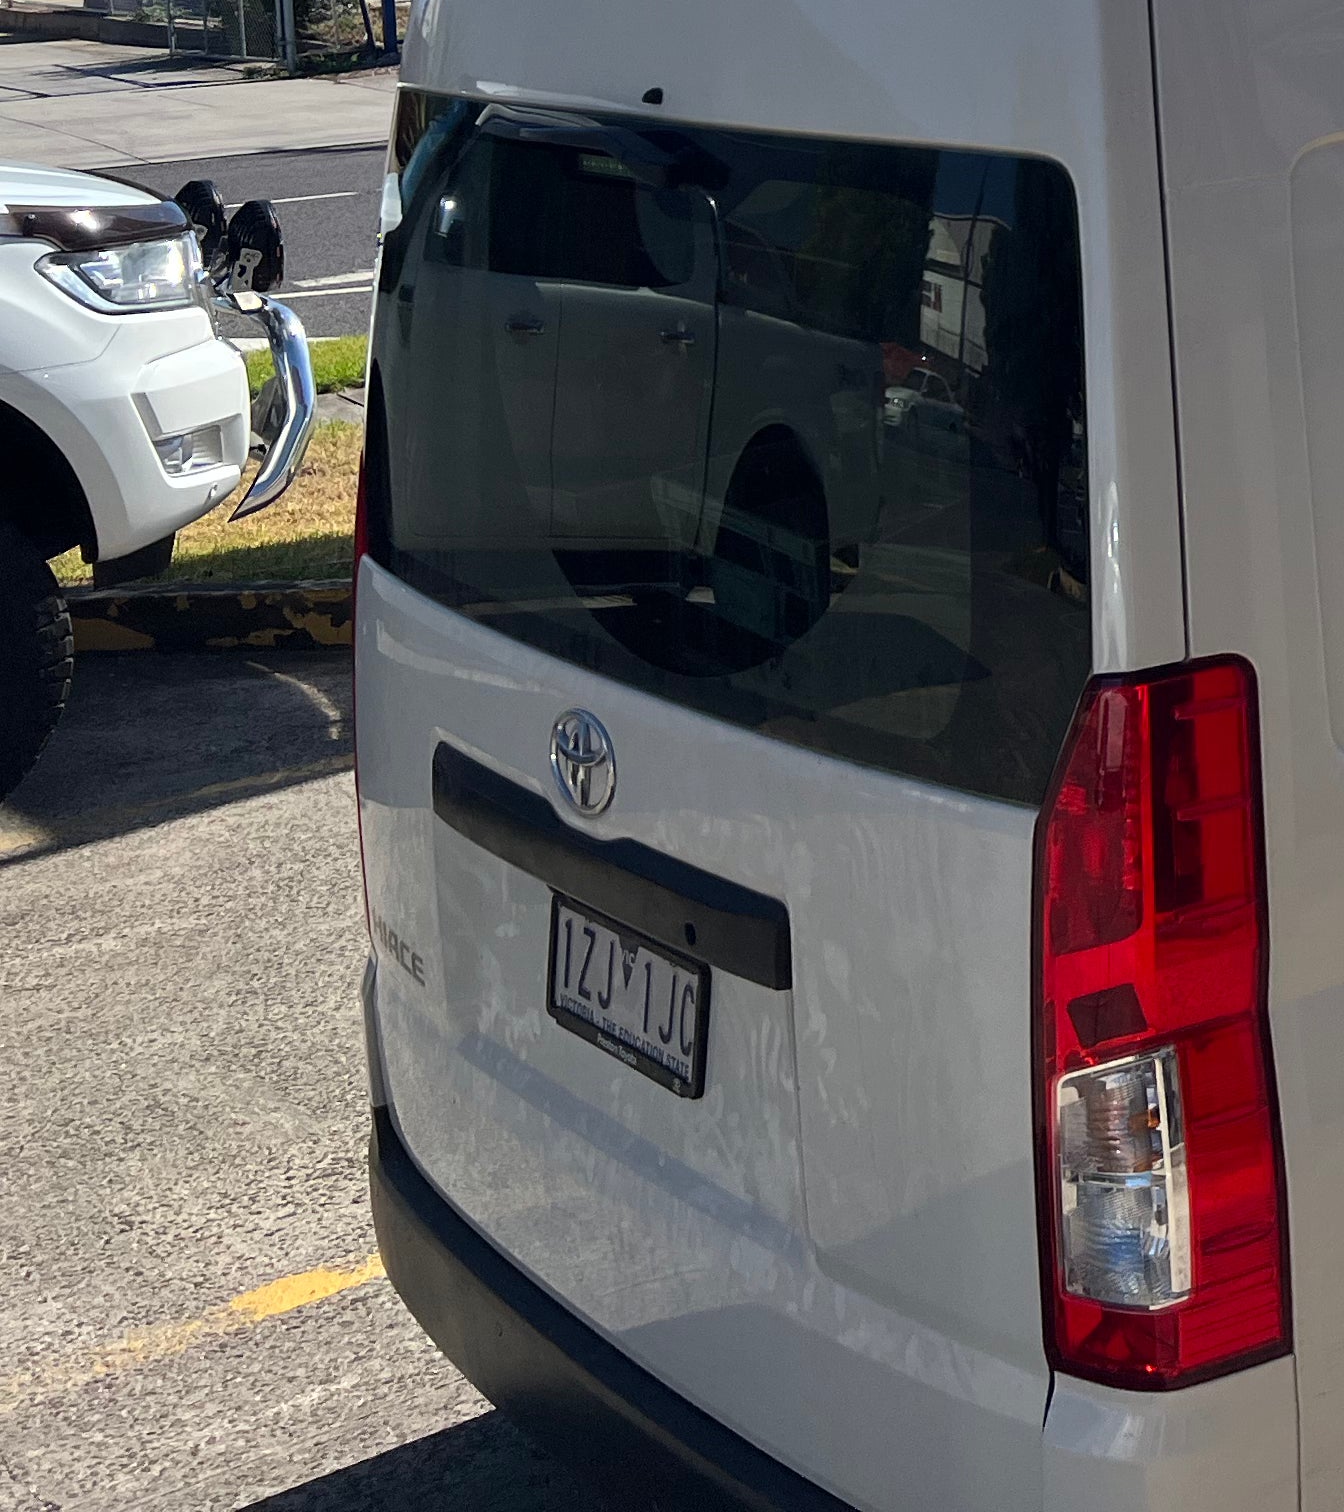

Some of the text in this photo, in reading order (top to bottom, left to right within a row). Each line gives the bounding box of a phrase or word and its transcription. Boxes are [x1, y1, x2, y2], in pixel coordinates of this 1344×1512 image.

[372, 906, 426, 988] HIACE
[560, 992, 594, 1025] VICTORIA
[602, 1016, 617, 1035] THE
[619, 1025, 665, 1066] EDUCATION
[666, 1052, 690, 1080] STATE
